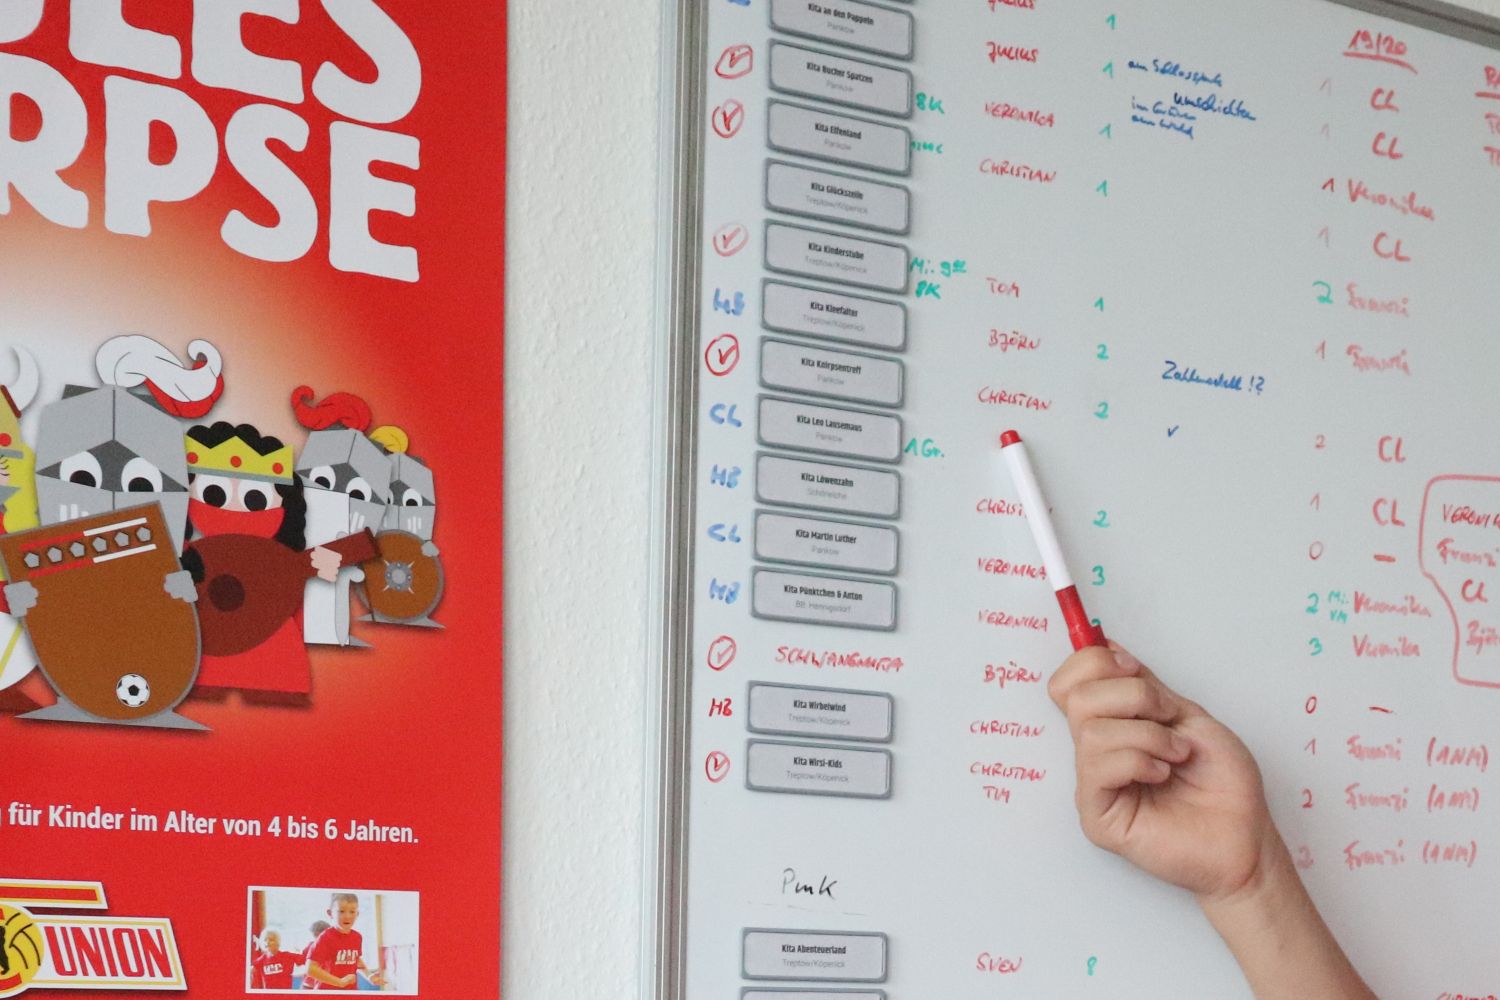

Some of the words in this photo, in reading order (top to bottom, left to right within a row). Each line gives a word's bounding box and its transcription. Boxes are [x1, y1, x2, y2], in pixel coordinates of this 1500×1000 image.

[1348, 29, 1408, 56] 19/20
[0, 0, 422, 124] LES
[0, 52, 421, 283] RPSE
[979, 158, 1057, 184] CHRISTIAN
[808, 242, 822, 252] Kita
[810, 301, 824, 311] Kita
[988, 329, 1041, 351] BJÖRN
[801, 358, 815, 367] Kita
[977, 385, 1053, 410] CHRISTIAN
[797, 415, 810, 424] Kita
[801, 473, 815, 481] Kita
[795, 529, 809, 538] Kita
[811, 531, 833, 541] Martin
[835, 533, 857, 545] Luther
[978, 558, 1047, 580] VERONIKA
[1092, 565, 1106, 586] 3
[784, 585, 798, 594] Kita
[800, 586, 835, 599] Pünktchen
[843, 592, 863, 601] Anton
[978, 610, 1049, 632] VERONIKA
[1308, 637, 1323, 657] 3
[983, 662, 1042, 690] BJÖRN
[793, 700, 807, 709] Kita
[808, 701, 846, 713] Wirbelwind
[970, 720, 1046, 738] CHRISTIAN
[793, 757, 807, 766] Kita
[809, 758, 842, 769] Wirsi-Kids
[970, 761, 1046, 782] CHRISTIAN
[8, 802, 42, 826] für
[48, 805, 124, 830] Kinder
[130, 808, 158, 832] im
[164, 810, 216, 835] Alter
[222, 816, 261, 837] von
[267, 817, 281, 838] 4
[287, 817, 319, 839] bis
[324, 818, 338, 840] 6
[344, 819, 419, 844] Jahren.
[44, 926, 173, 978] UNION
[782, 945, 796, 953] Kita
[797, 945, 846, 955] Abenteuerland
[976, 953, 1022, 975] SVEN
